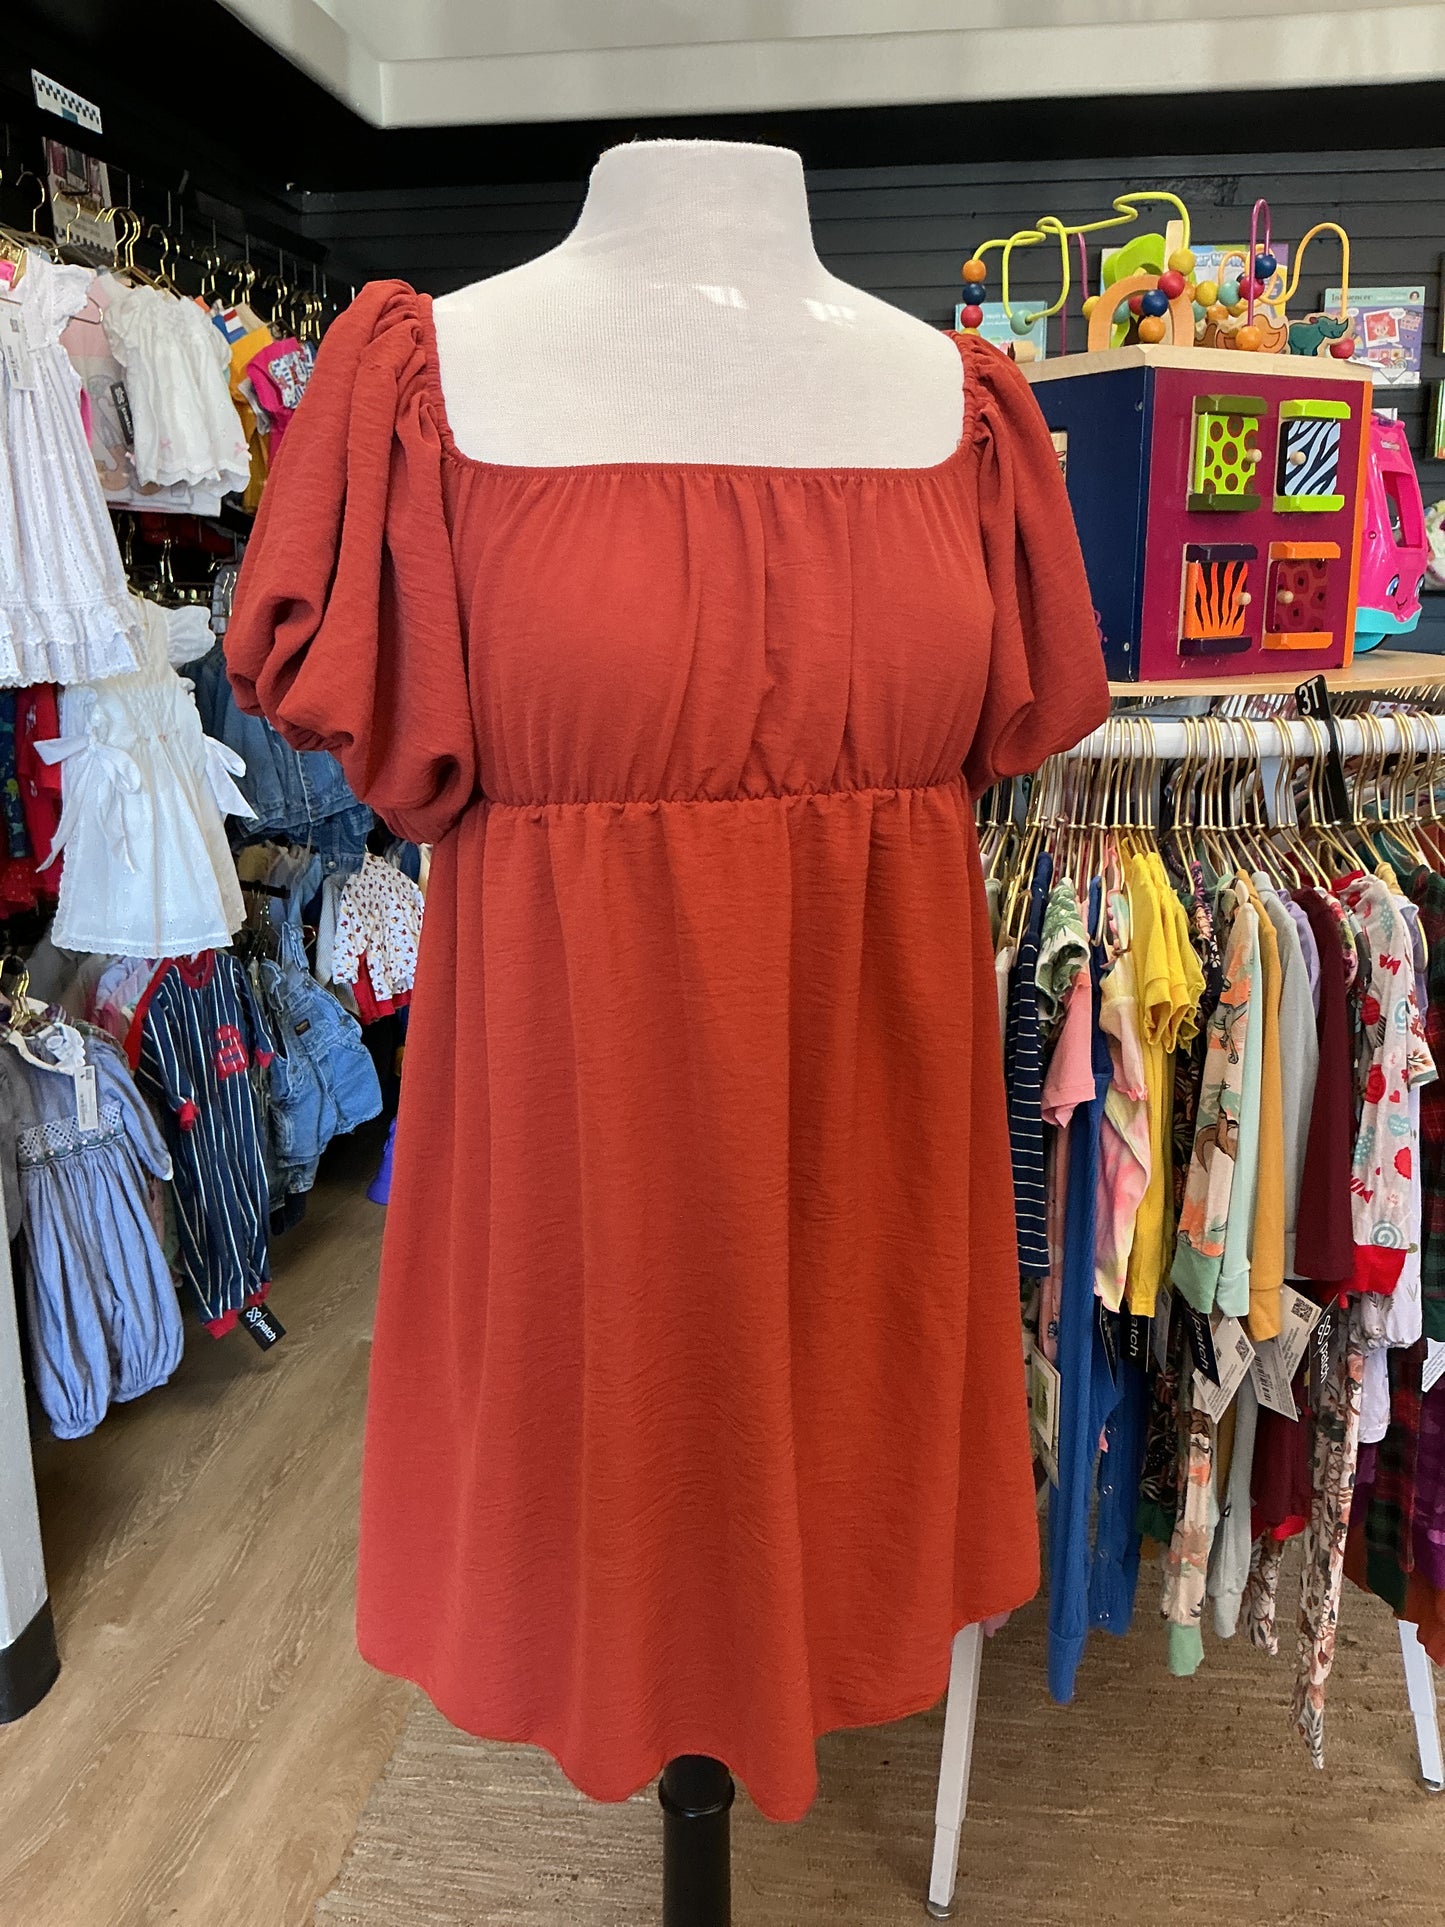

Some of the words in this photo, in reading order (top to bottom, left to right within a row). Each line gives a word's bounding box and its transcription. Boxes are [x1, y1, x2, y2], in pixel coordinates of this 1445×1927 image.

[1331, 293, 1371, 302] Infuencer
[1299, 677, 1319, 715] 3T
[256, 1319, 277, 1342] patch
[1130, 1317, 1139, 1357] atch
[1192, 1316, 1209, 1370] patch
[1320, 1341, 1330, 1384] patch
